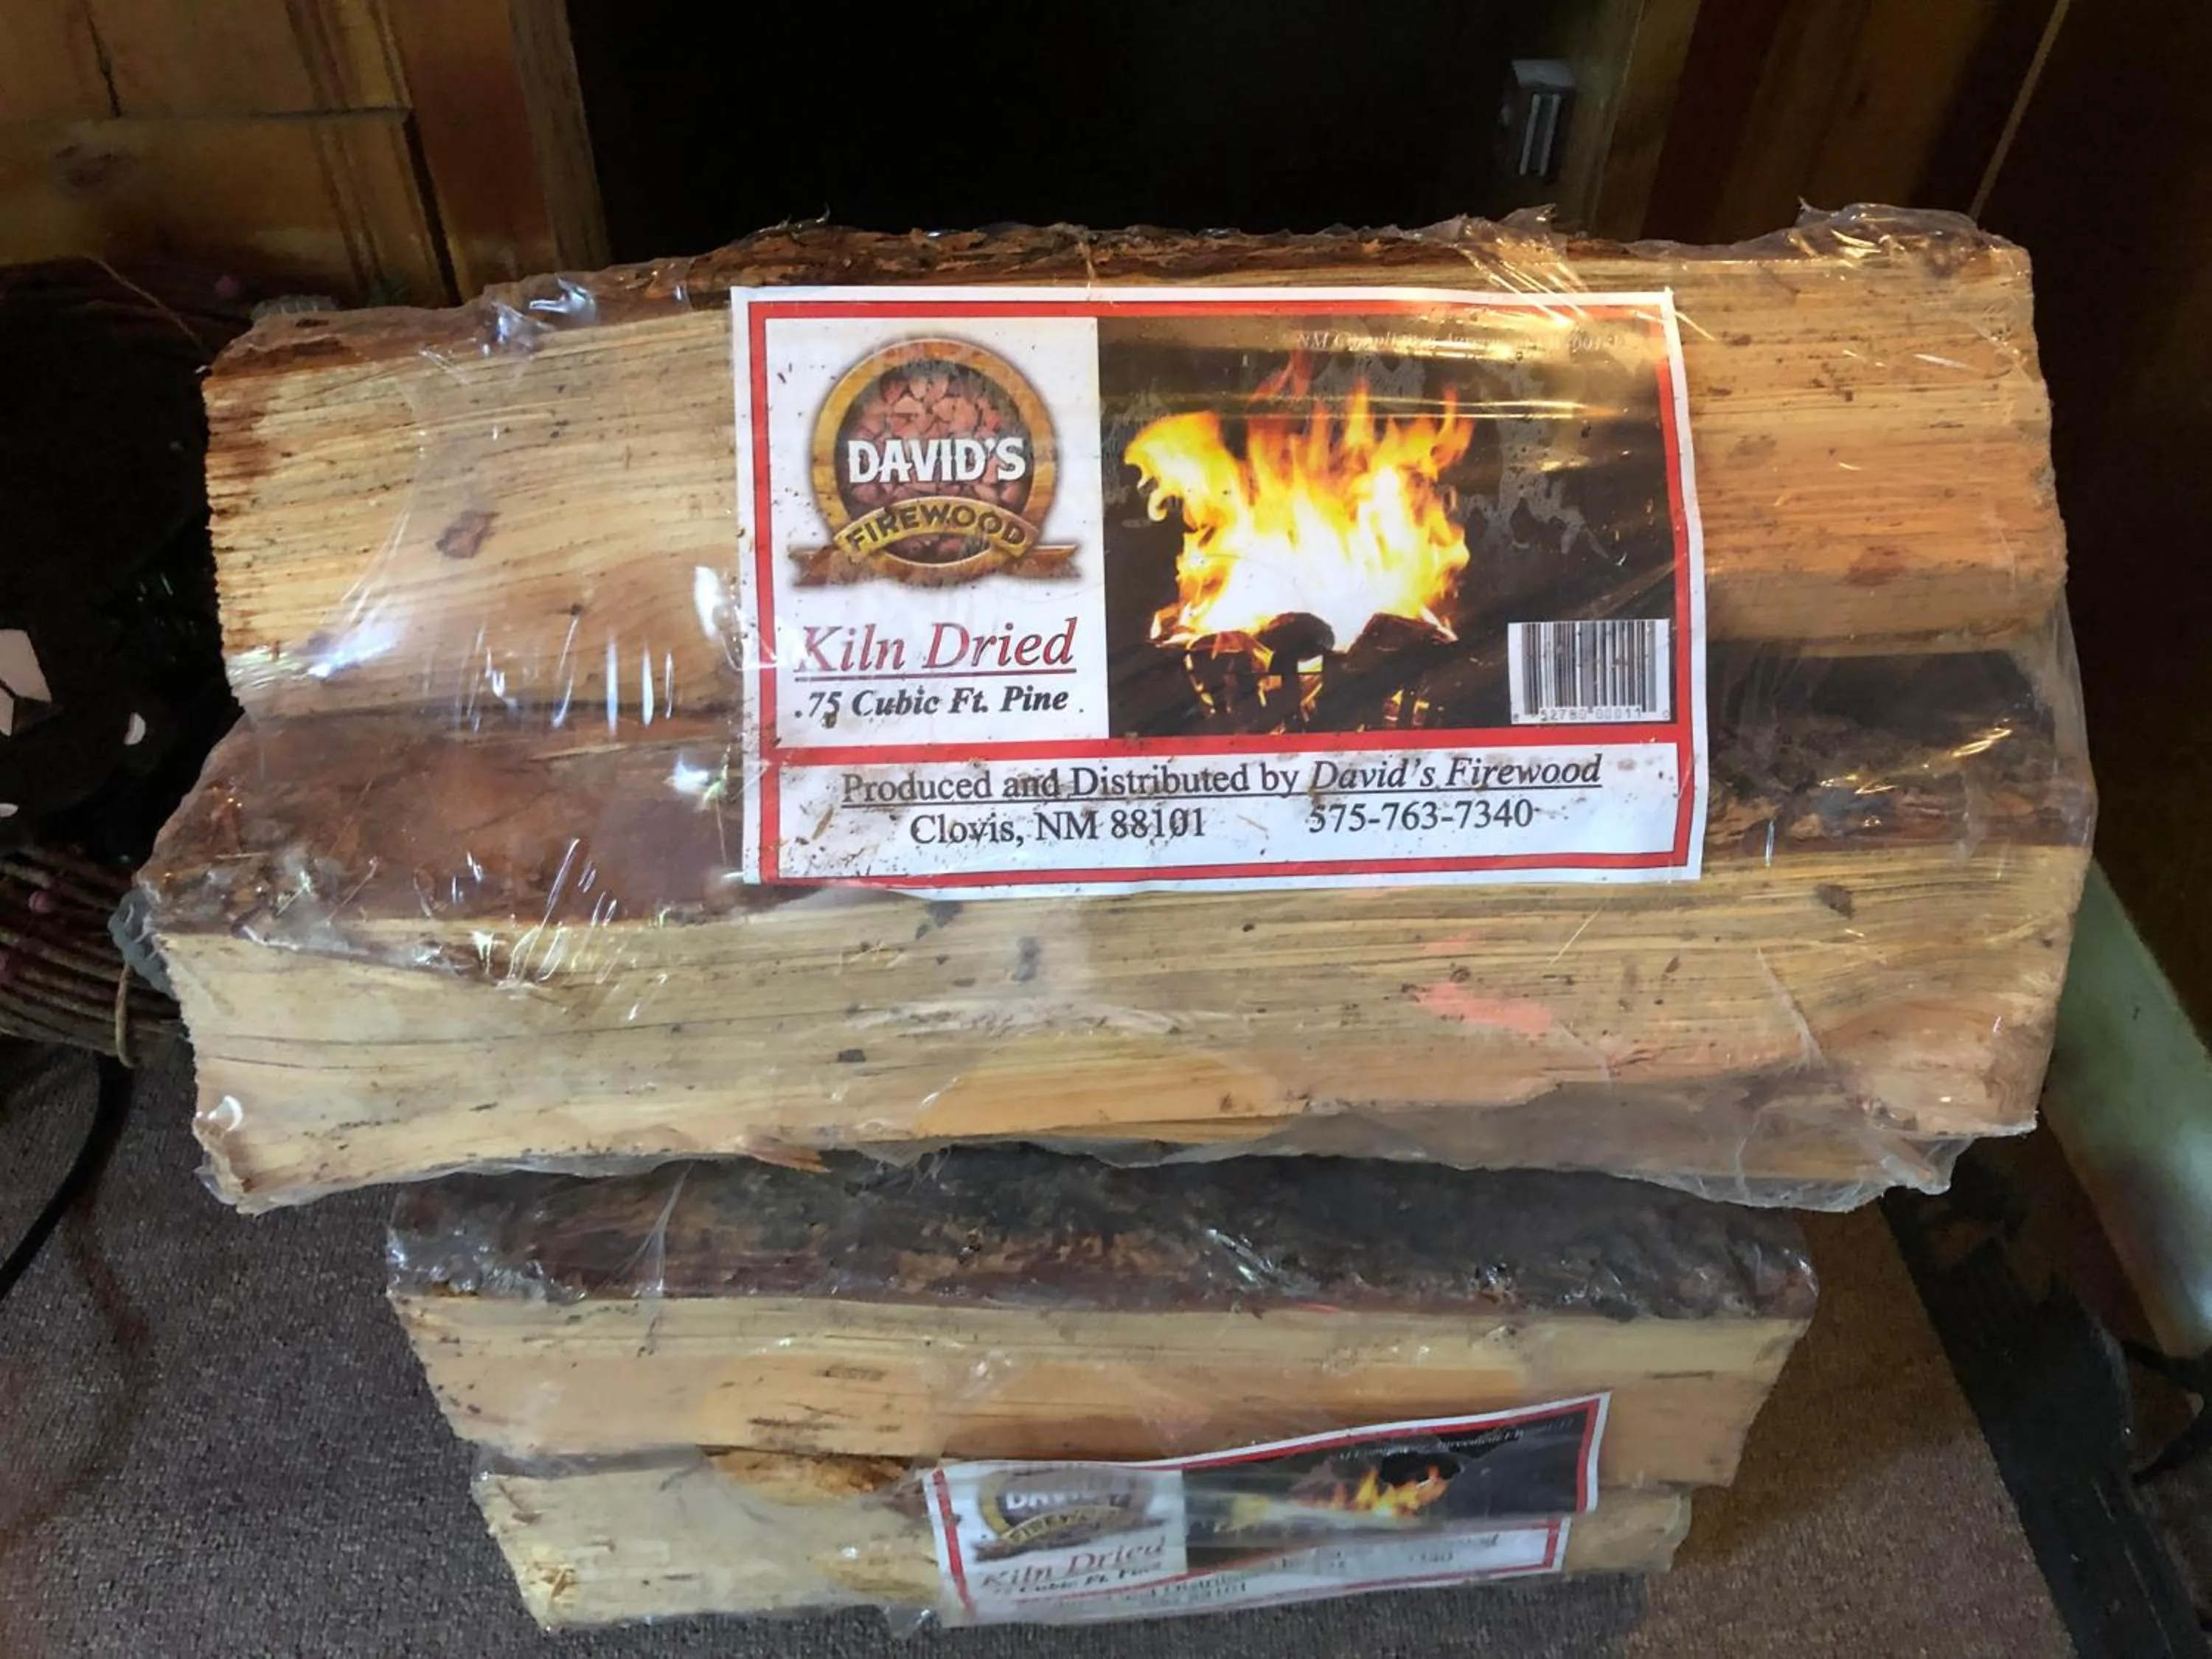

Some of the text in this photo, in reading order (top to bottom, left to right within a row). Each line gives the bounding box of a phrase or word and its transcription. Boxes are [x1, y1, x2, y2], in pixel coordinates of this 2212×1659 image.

[847, 437, 1026, 484] DAVID'S
[844, 503, 1027, 554] FIREWOOD
[793, 616, 1078, 673] Kiln Dried
[852, 686, 940, 717] Cubic
[950, 686, 990, 714] Ft.
[999, 685, 1069, 712] Pine
[842, 753, 1603, 804] Produced and Distributed by David's Firewood
[910, 807, 1206, 847] Clovis, NM 88101
[1309, 798, 1534, 833] 575-763-7340
